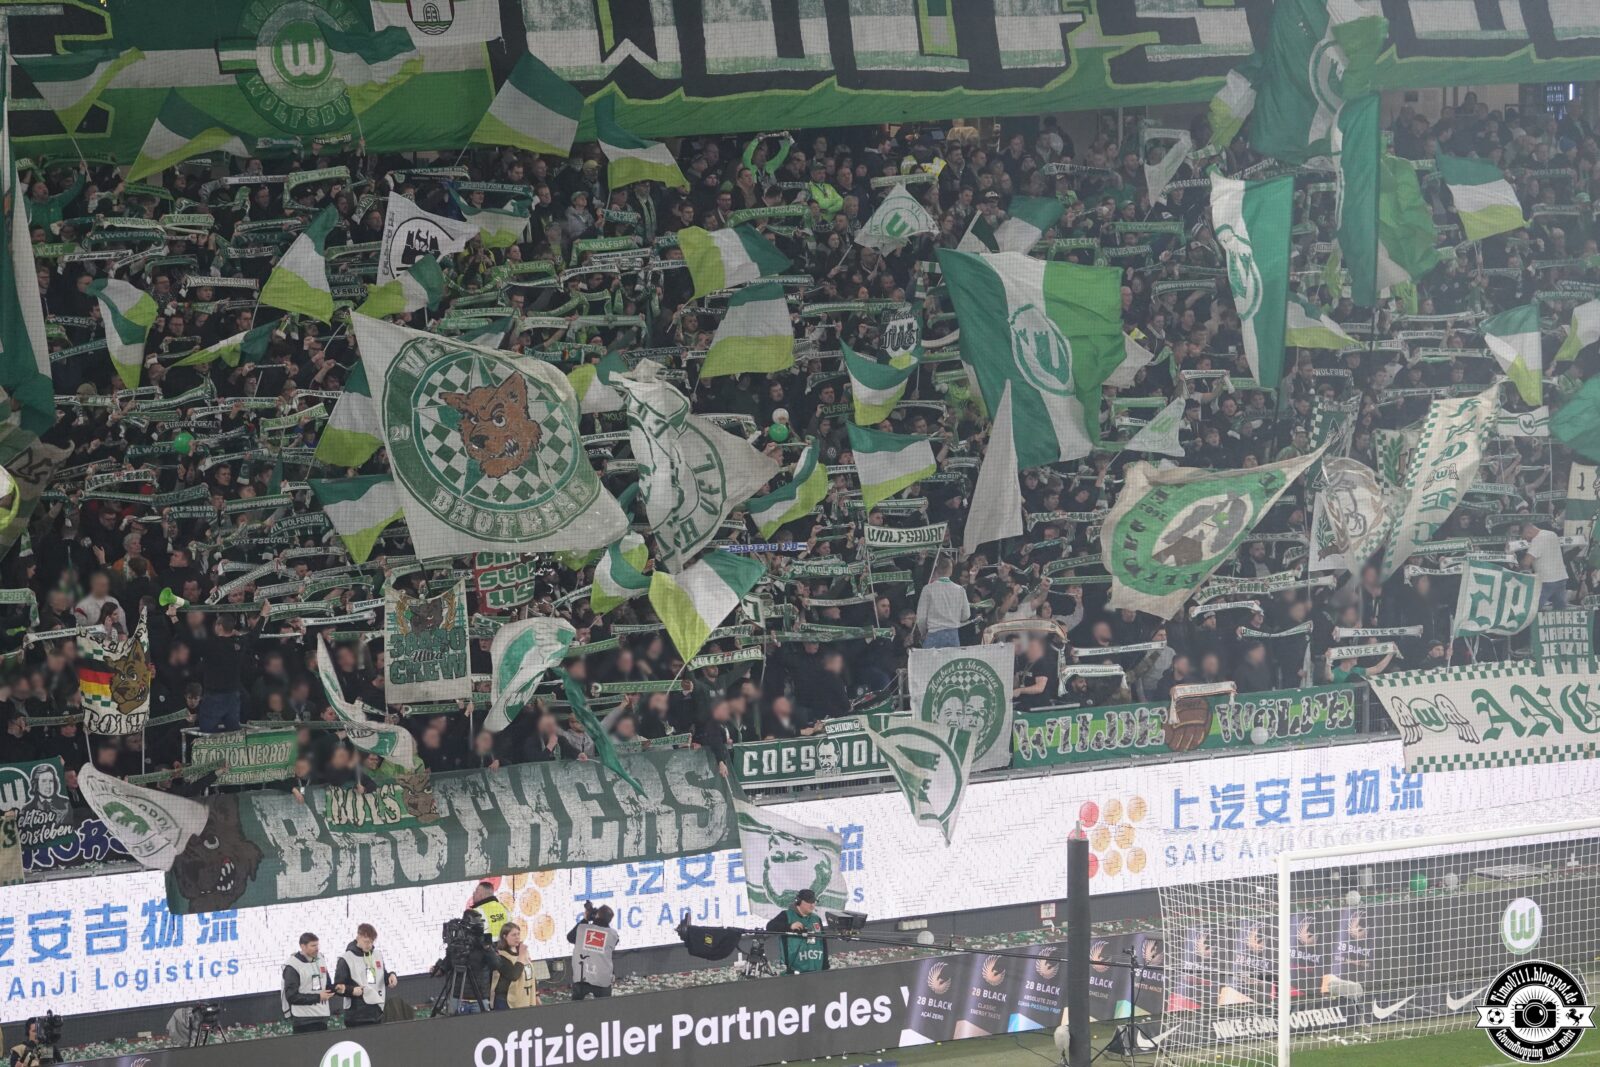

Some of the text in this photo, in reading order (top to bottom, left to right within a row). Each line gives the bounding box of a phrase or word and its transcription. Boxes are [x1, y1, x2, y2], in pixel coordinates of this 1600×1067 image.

[8, 955, 240, 1001] AnJi Logistics
[1089, 976, 1114, 989] BLACK
[971, 987, 1007, 1002] 28 BLACK
[1025, 980, 1060, 996] 28 BLACK
[916, 995, 927, 1006] 28
[928, 998, 953, 1012] BLACK
[473, 1019, 662, 1067] Offizieller
[672, 1002, 816, 1050] Partner
[824, 991, 892, 1030] des
